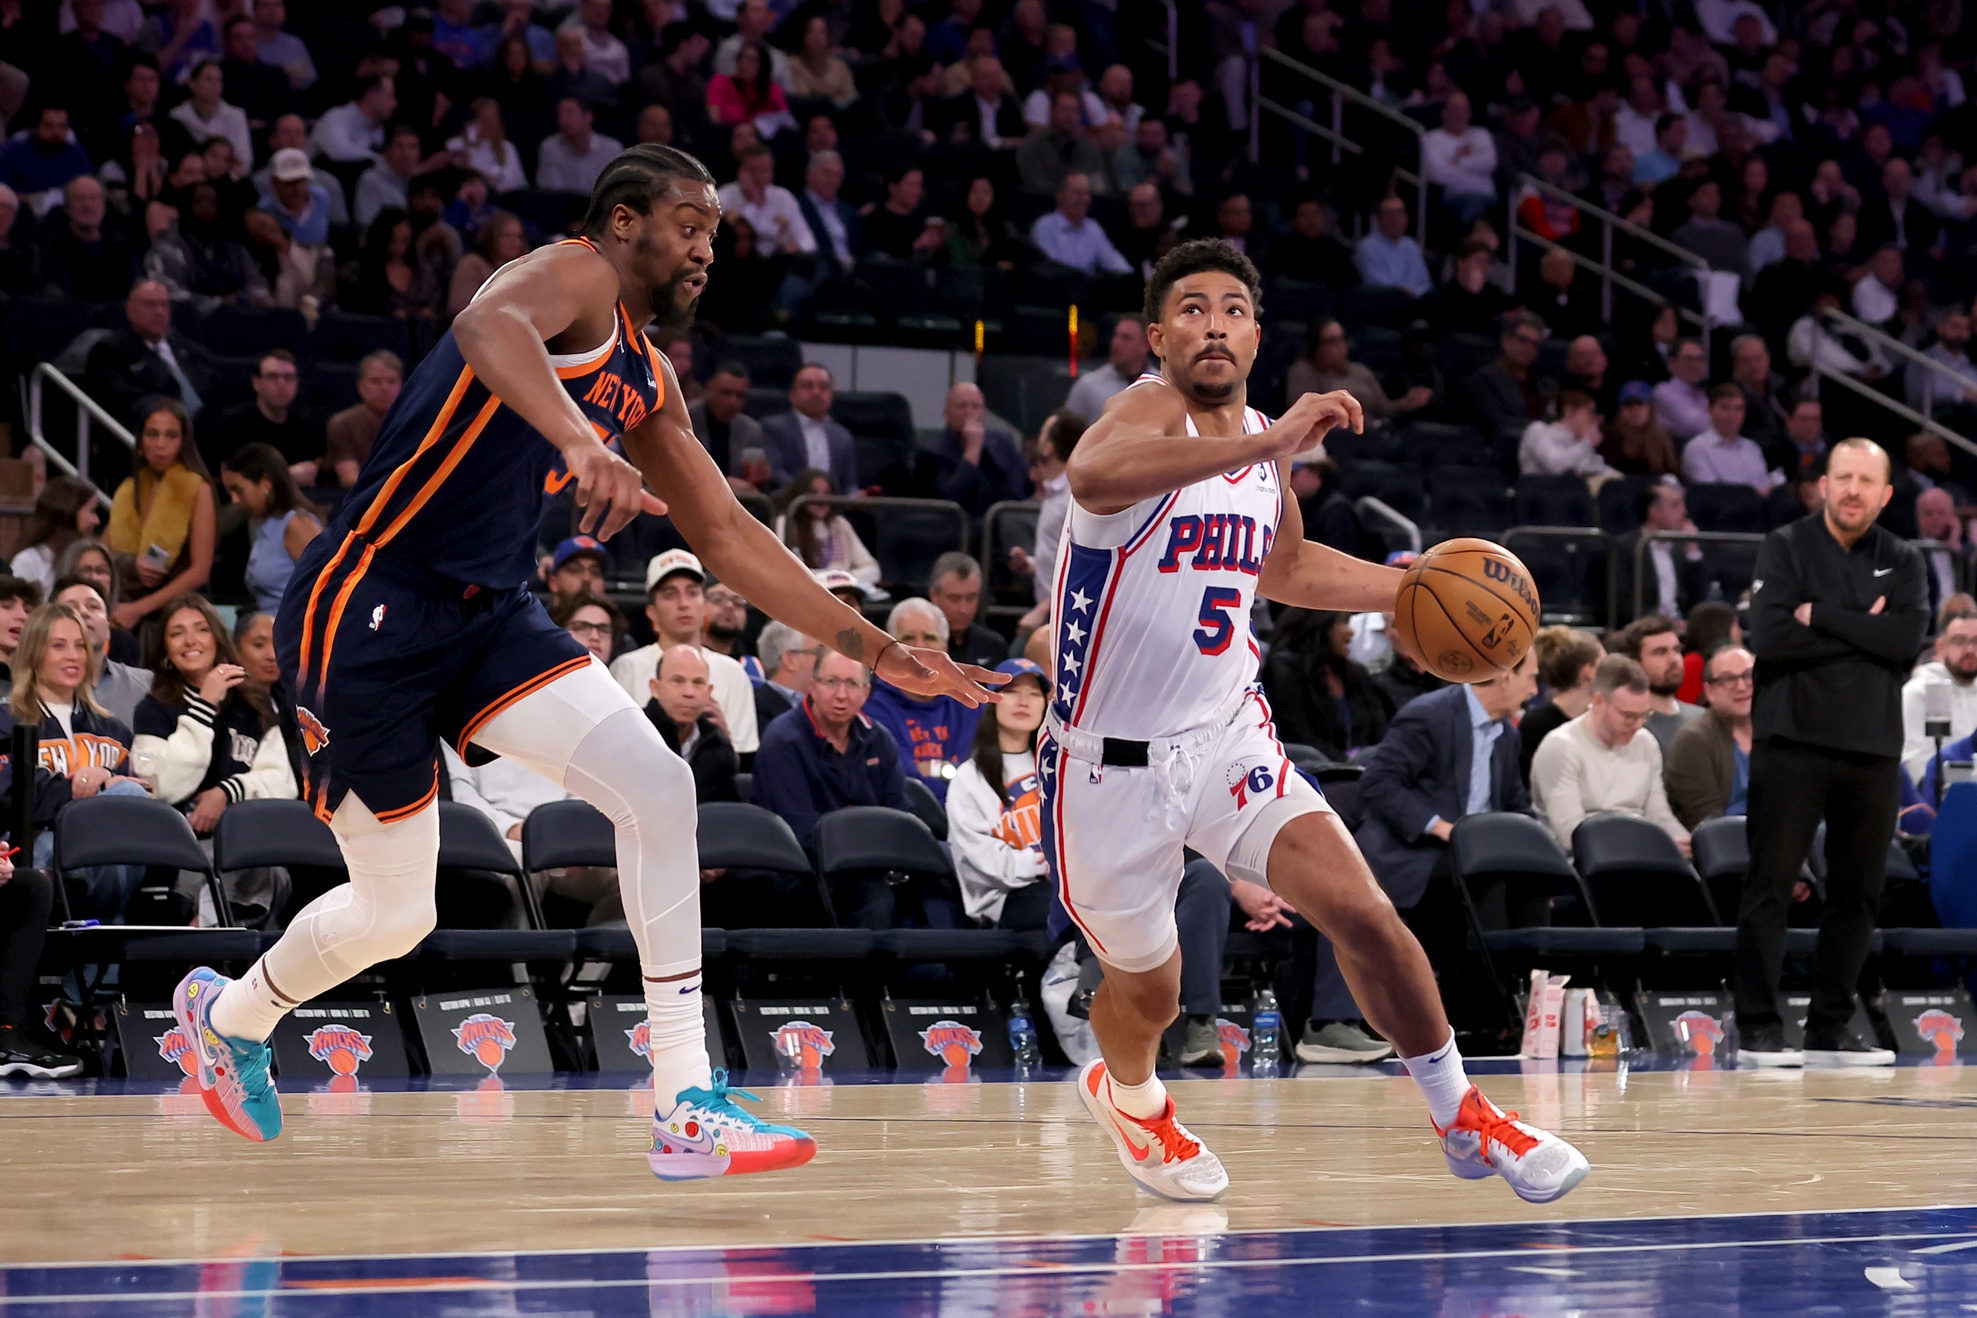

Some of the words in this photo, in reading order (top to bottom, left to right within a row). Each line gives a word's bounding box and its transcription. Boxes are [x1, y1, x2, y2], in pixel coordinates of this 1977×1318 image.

[1193, 586, 1241, 656] 5
[38, 744, 68, 777] EW
[83, 738, 120, 770] YOR
[1229, 765, 1274, 811] 76
[312, 1030, 371, 1054] KNICKS
[461, 1018, 514, 1047] KNICKS
[928, 1026, 981, 1049] KNICKS
